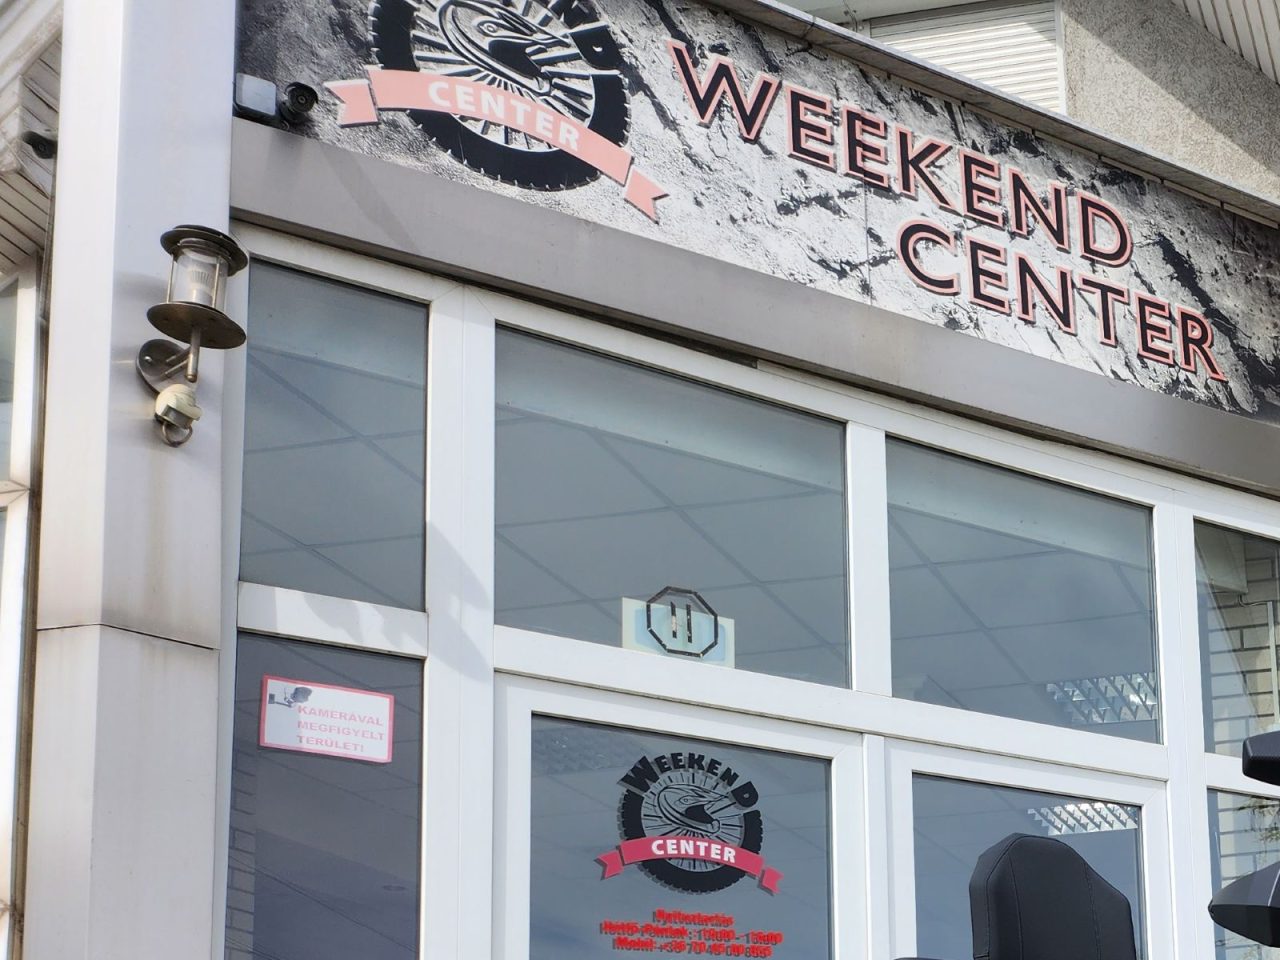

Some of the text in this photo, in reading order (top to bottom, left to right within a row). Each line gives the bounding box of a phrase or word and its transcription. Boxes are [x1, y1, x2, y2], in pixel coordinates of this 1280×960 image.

[428, 81, 580, 150] CENTER
[668, 39, 1133, 267] WEEKEND
[897, 217, 1227, 382] CENTER
[297, 720, 385, 741] MEGFIGYELT
[617, 752, 759, 808] WEEKEND
[651, 839, 736, 864] CENTER
